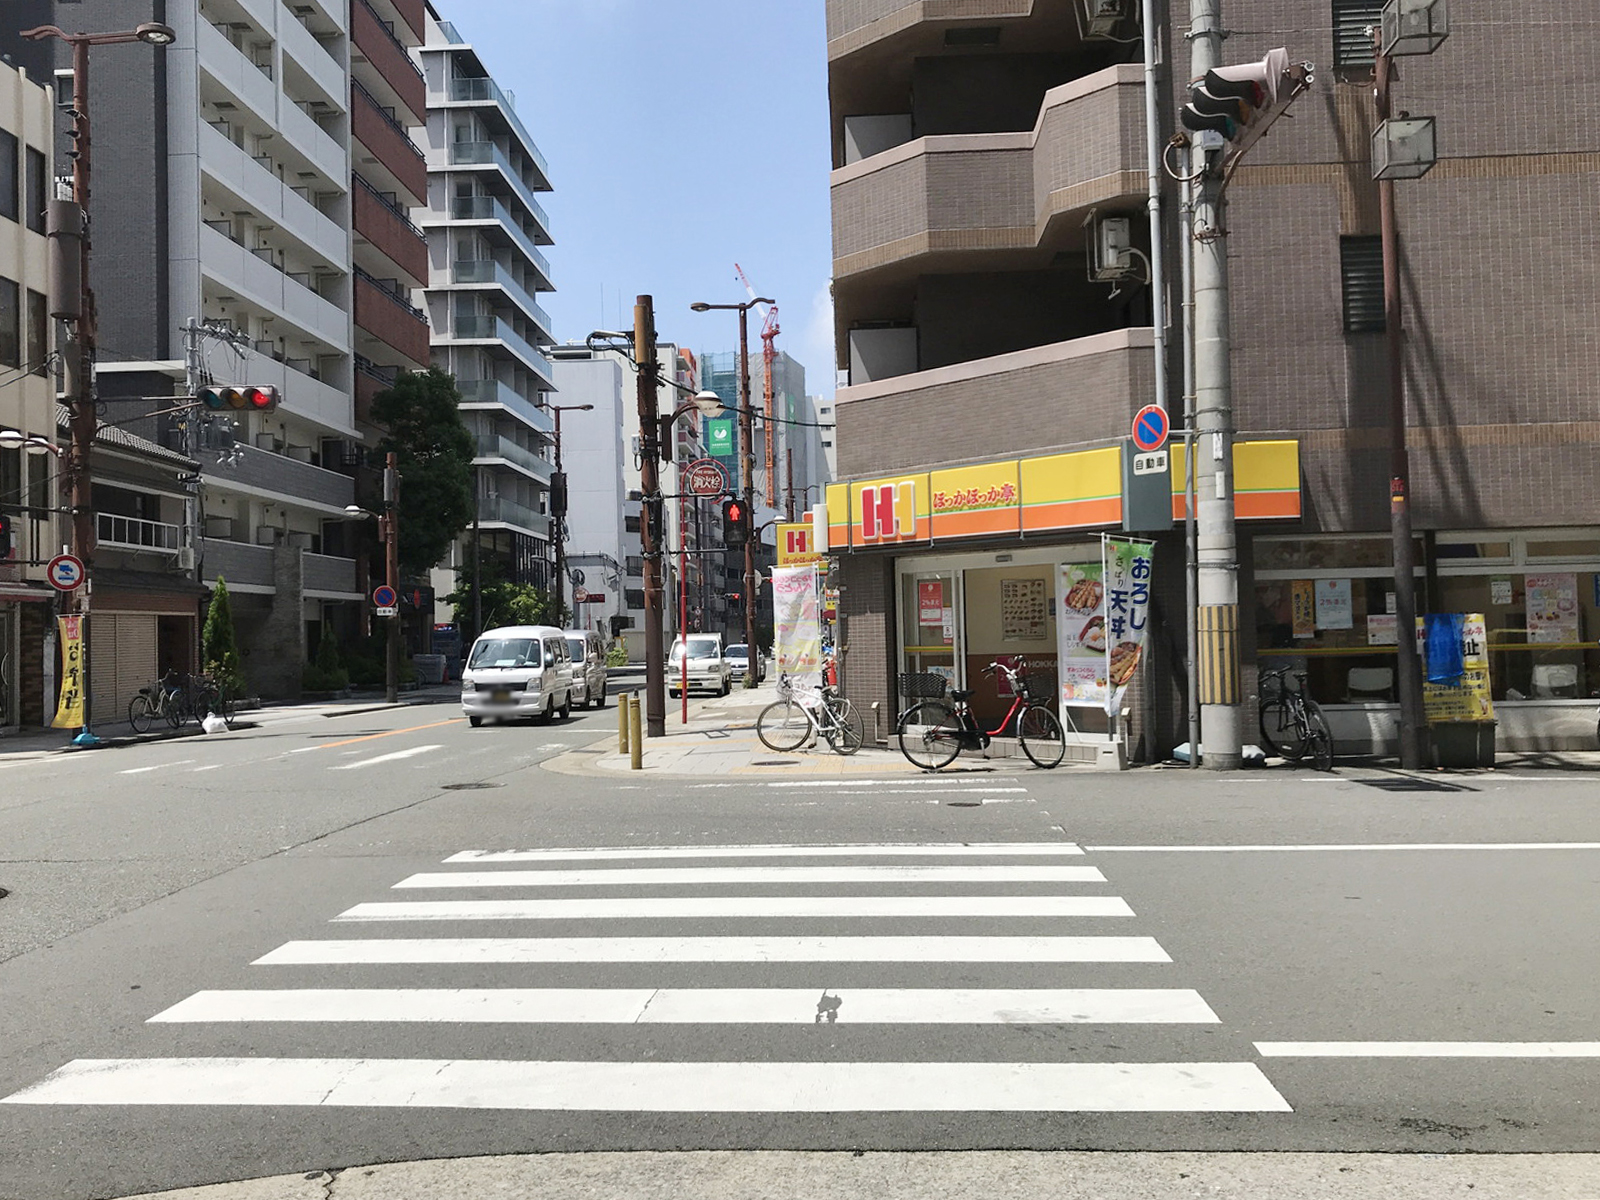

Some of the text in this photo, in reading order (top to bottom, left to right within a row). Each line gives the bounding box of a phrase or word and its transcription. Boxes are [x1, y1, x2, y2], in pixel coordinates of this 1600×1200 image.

[1135, 456, 1166, 471] 自動車
[693, 475, 721, 488] 消火栓
[932, 483, 1019, 510] ほっかほっか亭
[1130, 556, 1151, 630] おろし
[1110, 589, 1129, 639] 天丼
